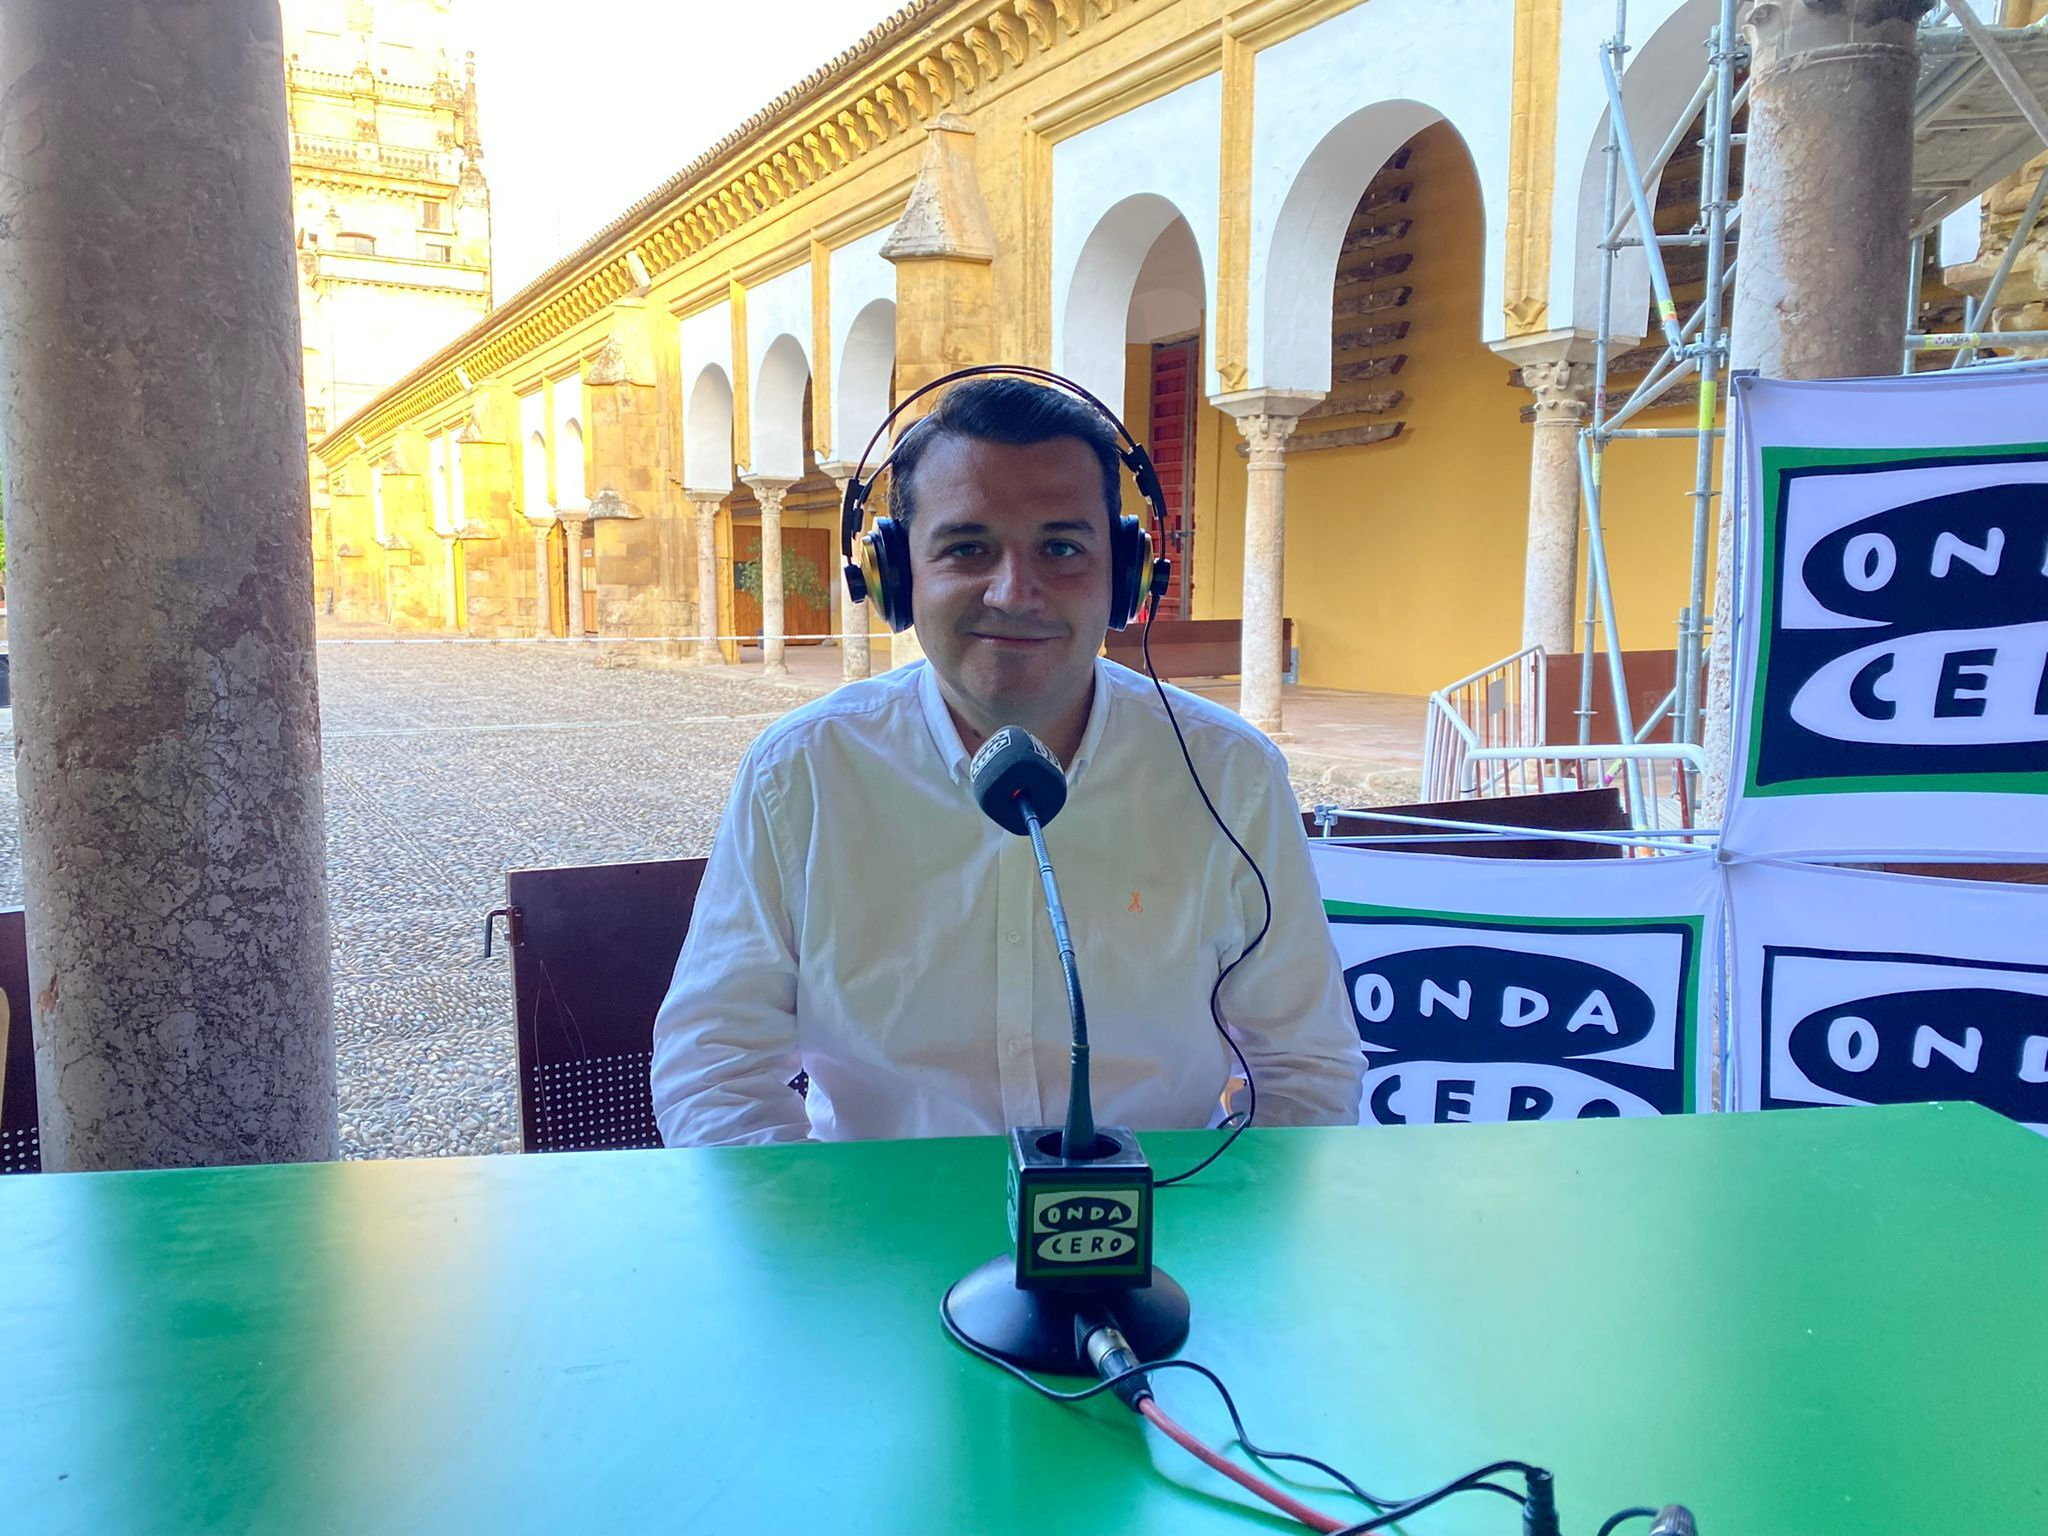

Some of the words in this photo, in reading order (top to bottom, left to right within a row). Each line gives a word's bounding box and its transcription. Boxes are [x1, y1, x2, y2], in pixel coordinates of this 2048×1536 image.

[1843, 527, 2048, 592] ON
[1850, 648, 2048, 721] CE
[1354, 973, 1619, 1035] ONDA
[1047, 1206, 1124, 1224] ONDA
[1051, 1236, 1122, 1255] CERO
